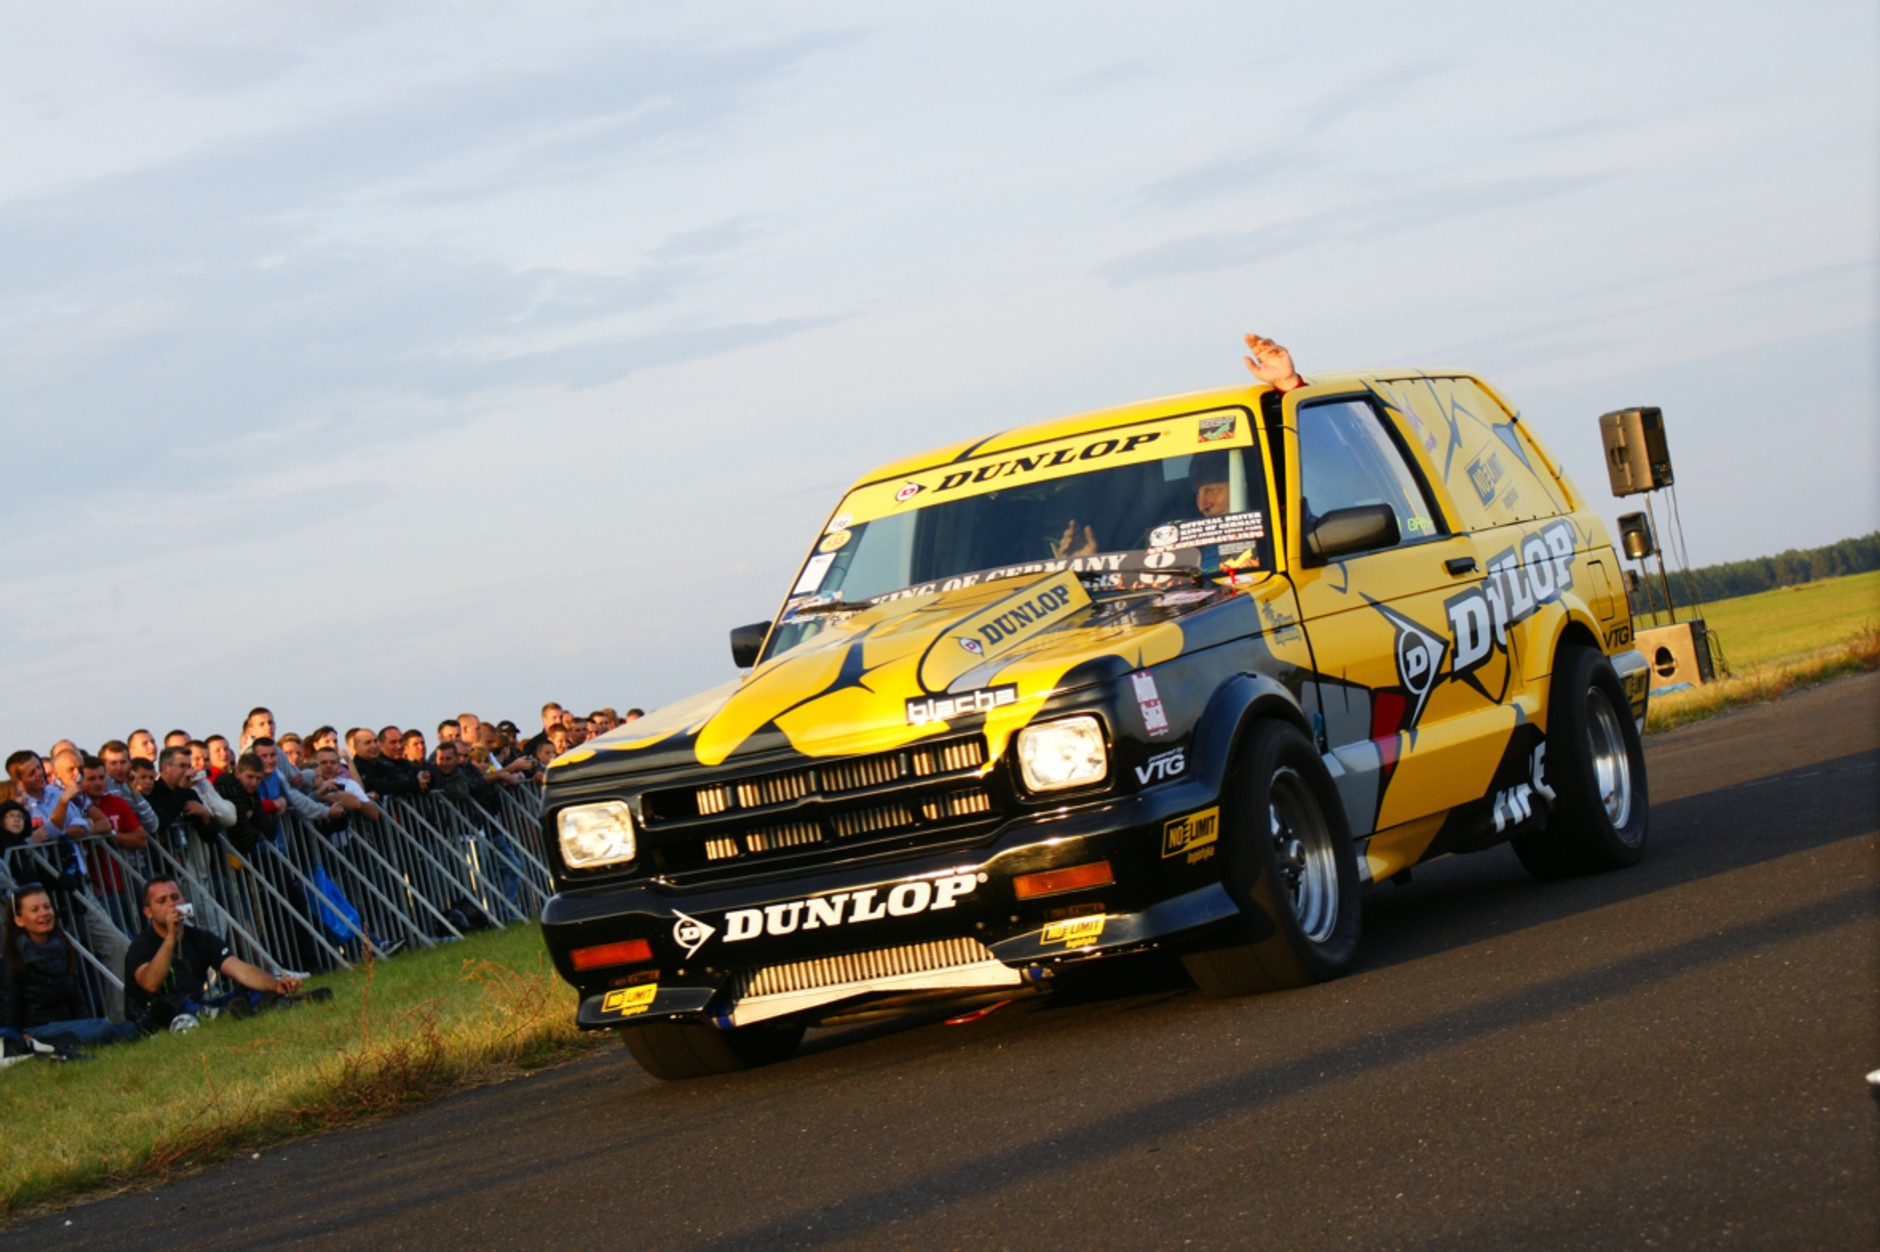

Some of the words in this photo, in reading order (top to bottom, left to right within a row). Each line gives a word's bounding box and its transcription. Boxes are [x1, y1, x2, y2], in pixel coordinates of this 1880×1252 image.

[931, 431, 1162, 494] DUNLOP
[1179, 516, 1223, 529] OFFICIAL
[1224, 511, 1262, 522] DRIVER
[941, 573, 981, 593] OF
[977, 583, 1070, 645] DUNLOP
[1602, 625, 1630, 649] VTG
[907, 687, 1017, 726] blacha
[1135, 754, 1186, 785] VTG
[1168, 826, 1183, 849] NO
[1190, 815, 1216, 843] LIMIT
[722, 873, 978, 942] DUNLOP
[1070, 921, 1099, 935] LIMIT
